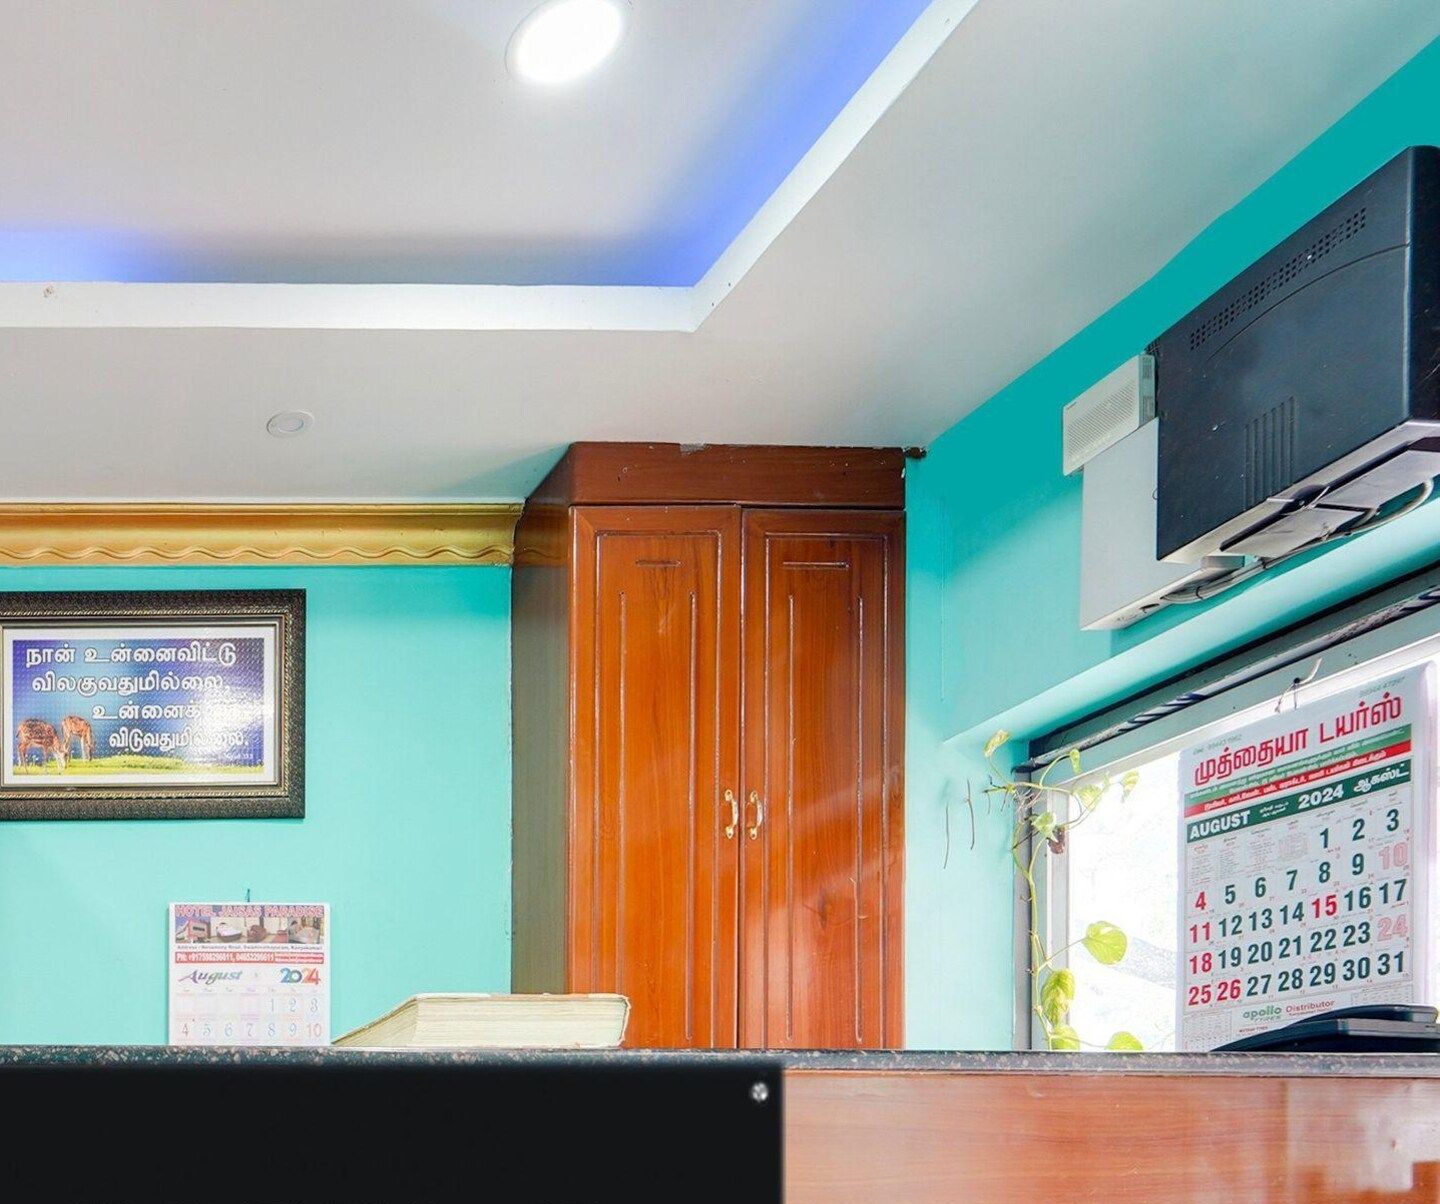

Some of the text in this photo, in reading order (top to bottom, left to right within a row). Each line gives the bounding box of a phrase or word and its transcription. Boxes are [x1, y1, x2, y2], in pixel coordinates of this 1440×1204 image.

[25, 641, 237, 669] நான் உன்னைவிட்டு
[1194, 728, 1309, 786] முத்தையா
[1319, 691, 1402, 744] டயர்ஸ்
[1189, 810, 1251, 840] AUGUST
[1298, 783, 1345, 810] 2024
[1319, 808, 1400, 850] 1 2 3
[1195, 841, 1408, 911] 4 5 6 7 8 9 10
[1189, 878, 1407, 943] 11 12 13 14 15 16 17
[1189, 913, 1408, 975] 18 19 20 21 22 23 24
[177, 967, 322, 986] August 2024
[1188, 950, 1404, 1006] 25 26 27 28 29 30 31
[1242, 1005, 1283, 1020] apollo
[1285, 1000, 1335, 1013] Distributor
